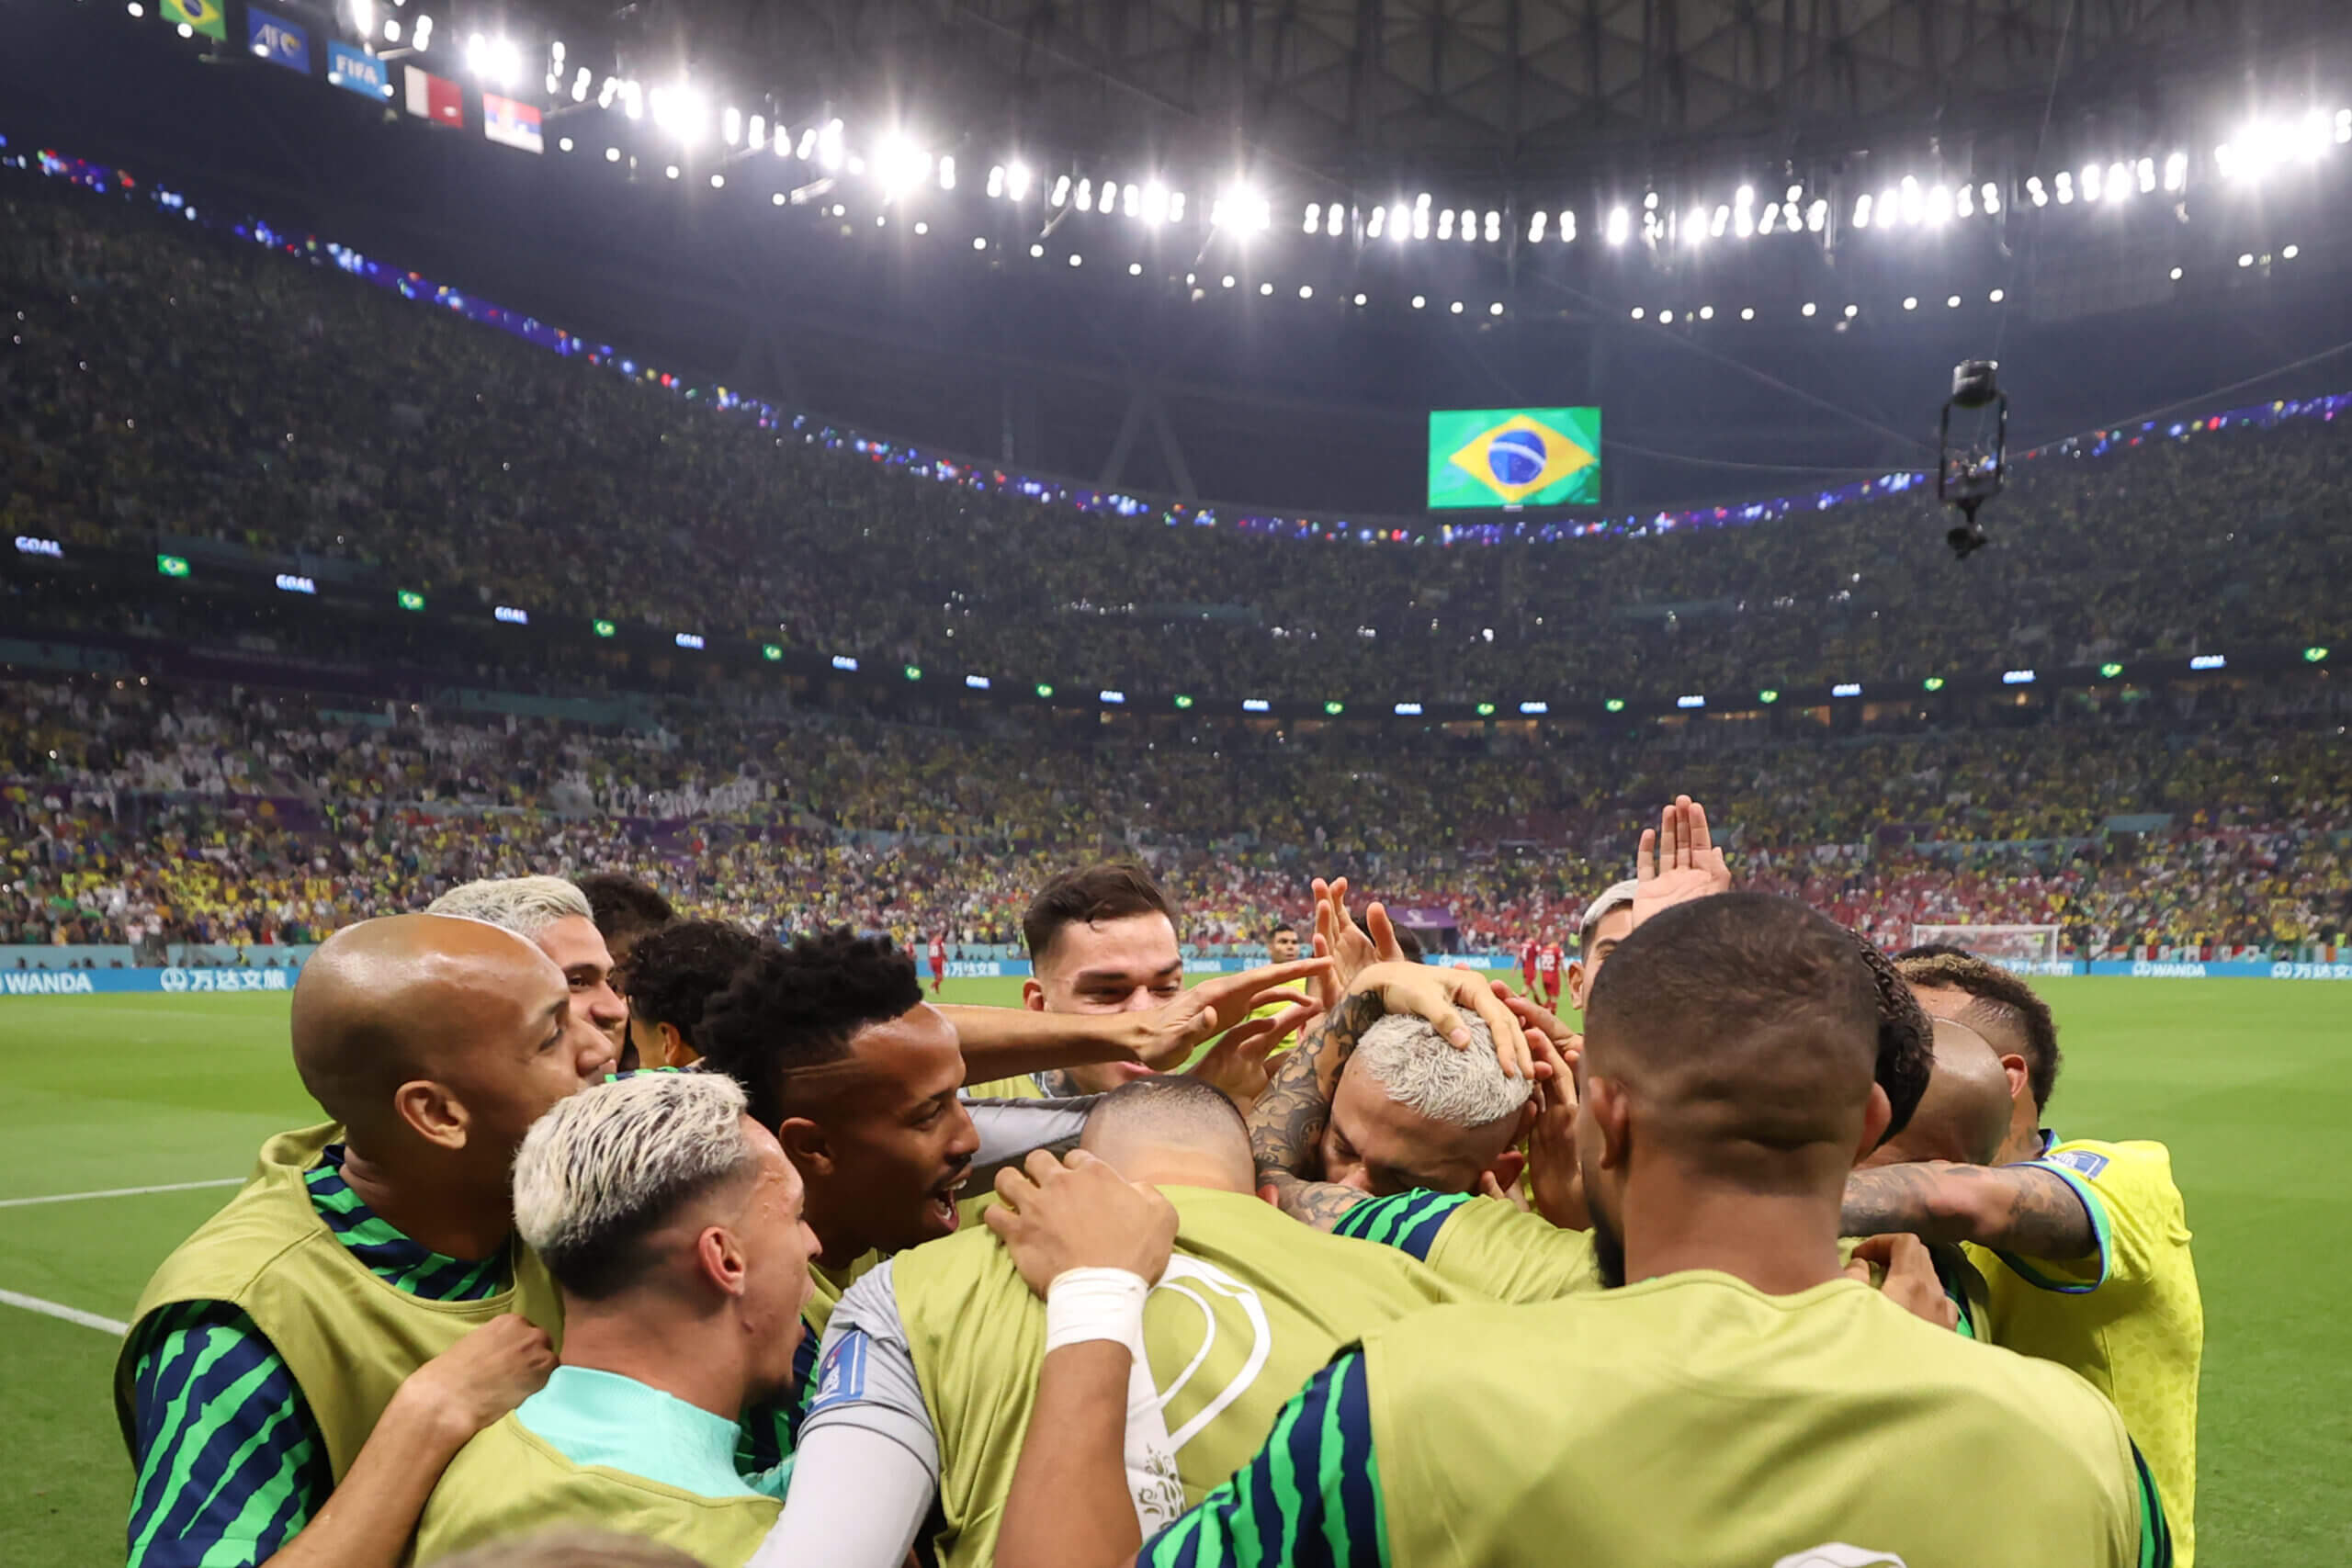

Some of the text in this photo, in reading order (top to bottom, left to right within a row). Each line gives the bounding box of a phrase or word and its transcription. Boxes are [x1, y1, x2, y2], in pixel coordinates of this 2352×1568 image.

[335, 53, 379, 87] FIFA
[15, 536, 63, 558] GOAL
[276, 573, 316, 594] GOAL
[2154, 963, 2206, 977] WANDA
[5, 972, 93, 994] WANDA
